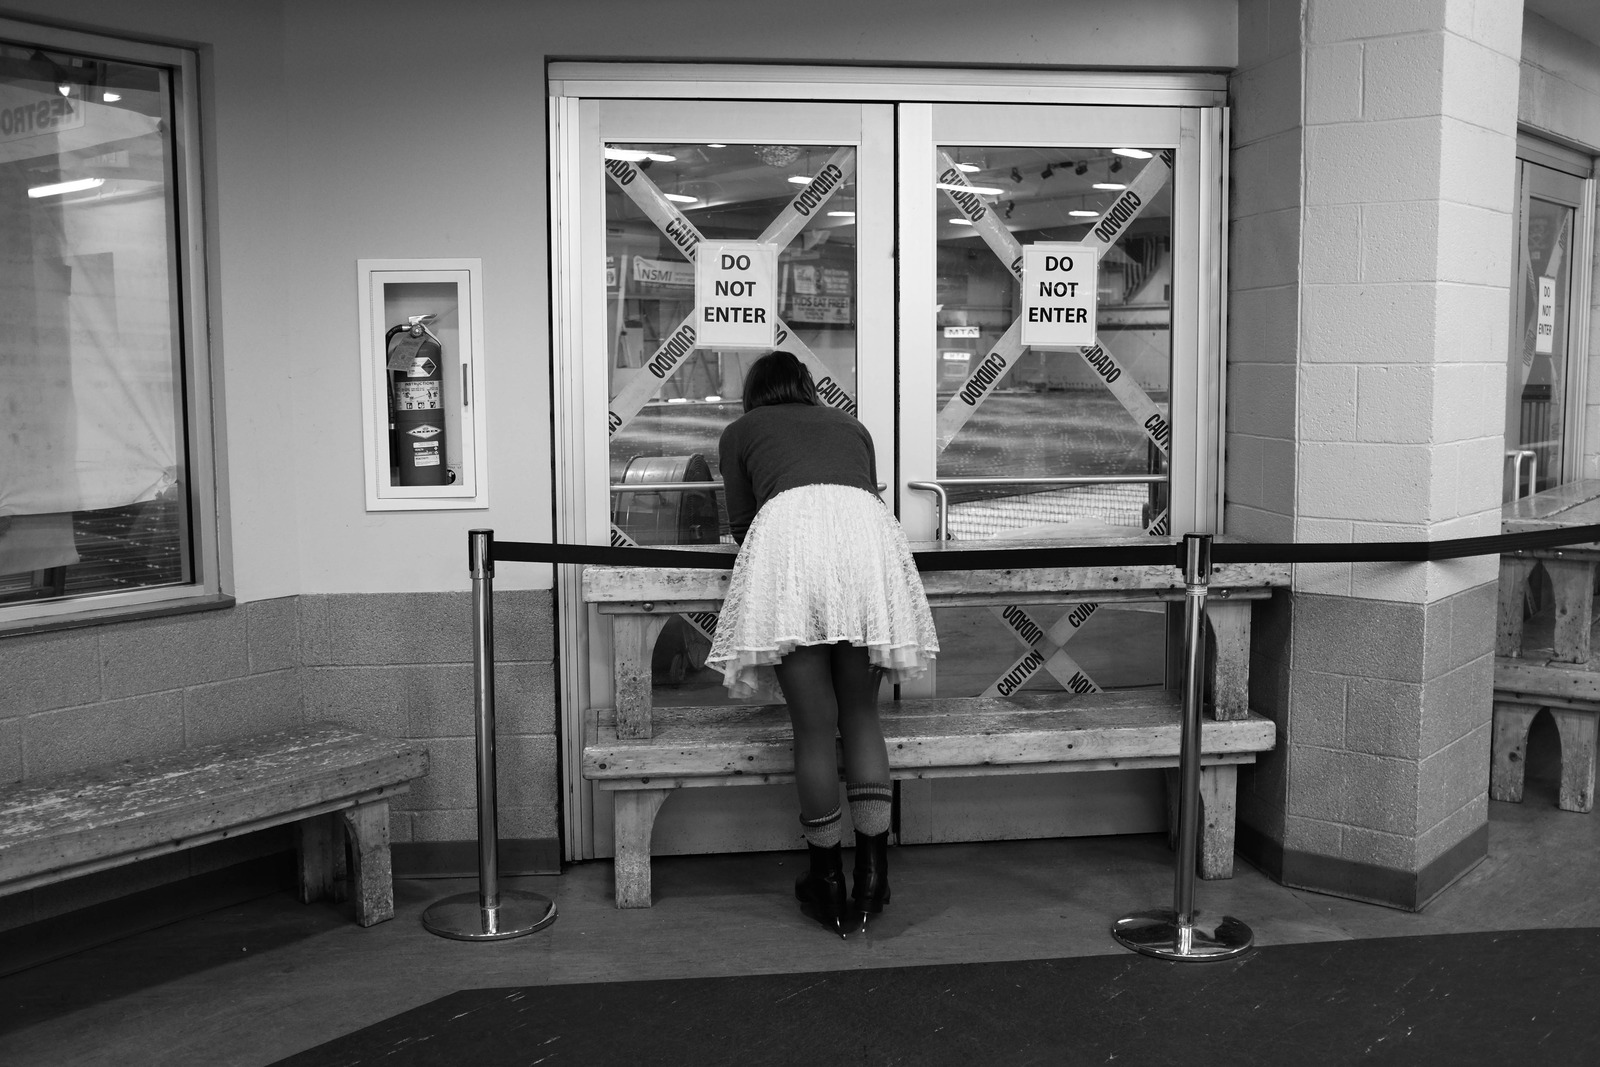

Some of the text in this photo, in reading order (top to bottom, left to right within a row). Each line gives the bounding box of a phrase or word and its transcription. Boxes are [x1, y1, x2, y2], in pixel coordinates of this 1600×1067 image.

[793, 164, 843, 216] CUIDADO
[1094, 190, 1142, 244] CUIDADO
[721, 254, 751, 271] DO
[1045, 256, 1074, 272] DO
[715, 280, 756, 297] NOT
[1039, 281, 1079, 298] NOT
[1544, 286, 1550, 298] DO
[704, 306, 766, 324] ENTER
[1028, 307, 1088, 324] ENTER
[1542, 305, 1551, 317] NOT
[1538, 323, 1552, 336] ENTER
[648, 324, 696, 379] CUIDADO
[959, 352, 1007, 406] CUIDADO
[1002, 605, 1044, 647] UIDADO
[997, 649, 1045, 697] CAUTION
